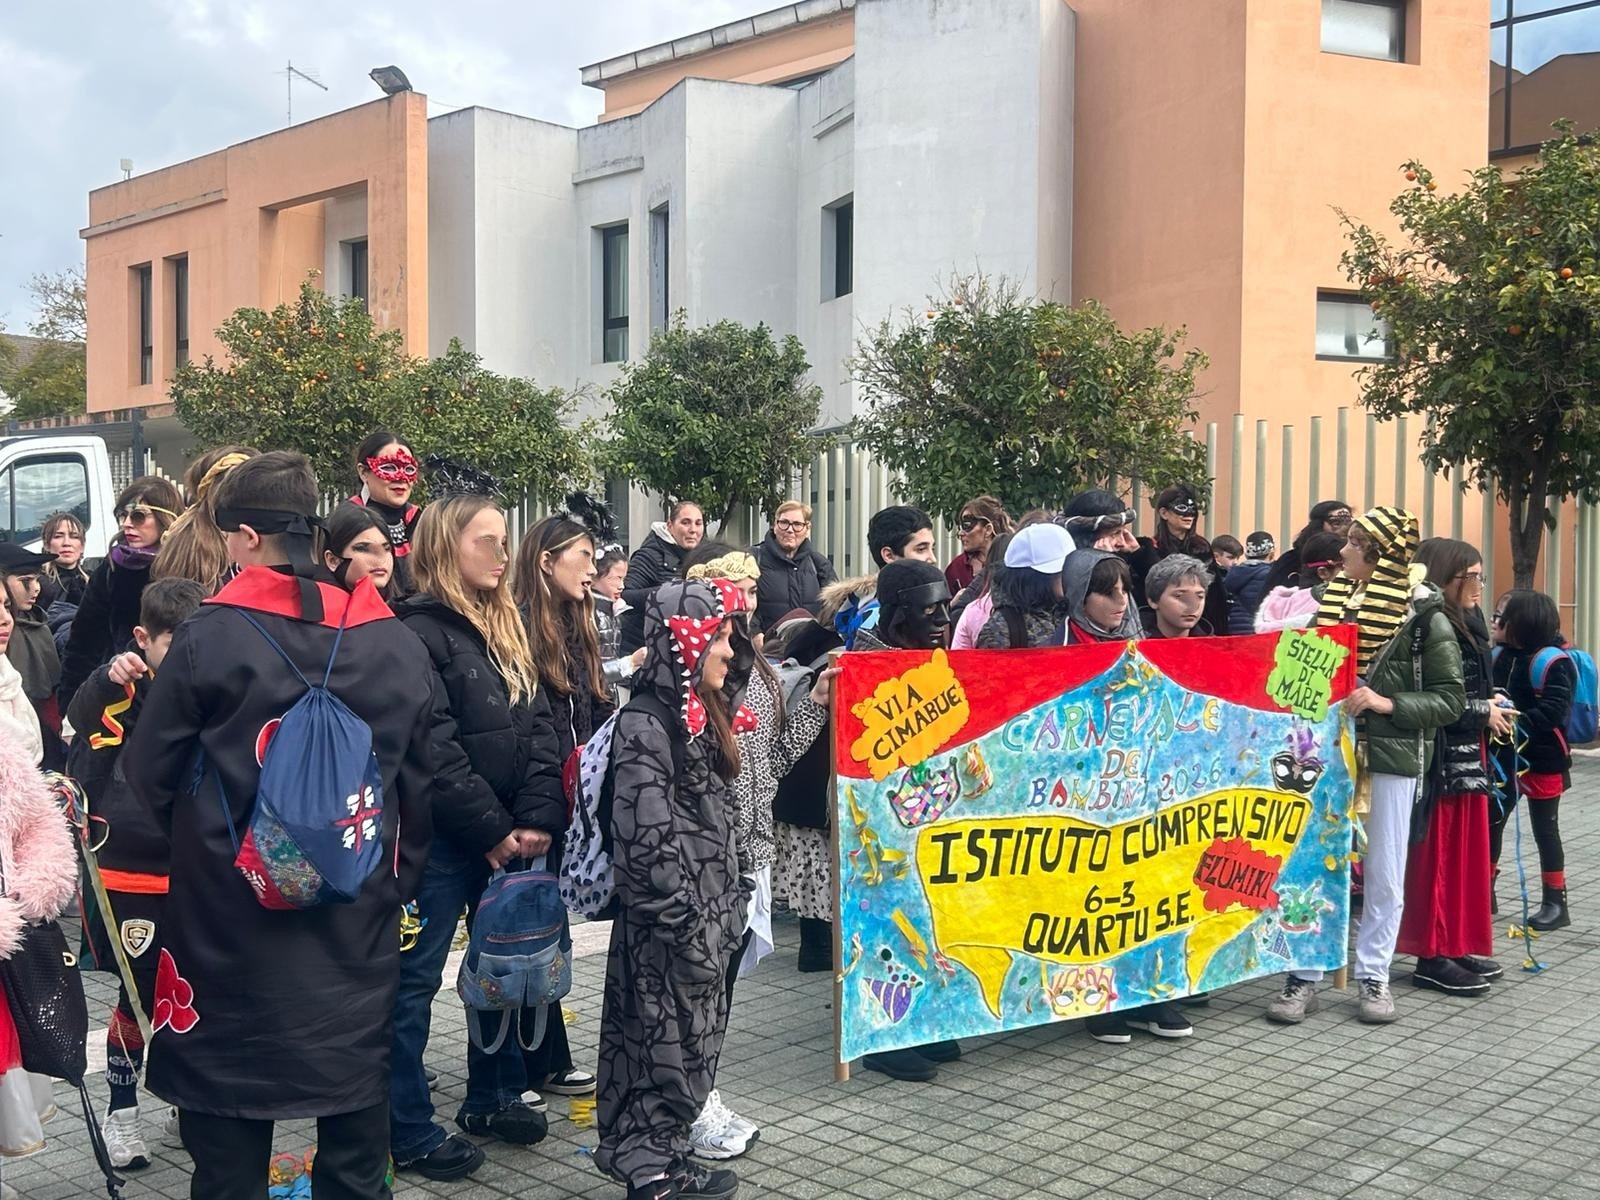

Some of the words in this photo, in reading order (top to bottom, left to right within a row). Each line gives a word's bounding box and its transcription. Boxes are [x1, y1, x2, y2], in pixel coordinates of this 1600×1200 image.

[1287, 638, 1337, 680] STELLA
[1297, 666, 1315, 686] DI
[873, 683, 924, 721] VIA
[1275, 673, 1324, 713] MARE
[872, 683, 963, 761] CIMABUE
[1001, 691, 1221, 752] CARNEVALE
[1027, 776, 1151, 811] BAMBINI
[1156, 756, 1223, 803] 2026
[1100, 745, 1153, 780] DEI
[929, 826, 1112, 885] ISTITUTO
[1121, 796, 1306, 866] COMPRENSIVO
[1084, 880, 1136, 914] 6-3
[1194, 850, 1275, 900] FLUMINI
[1022, 906, 1149, 957] QUARTU
[1154, 890, 1195, 932] S.E.
